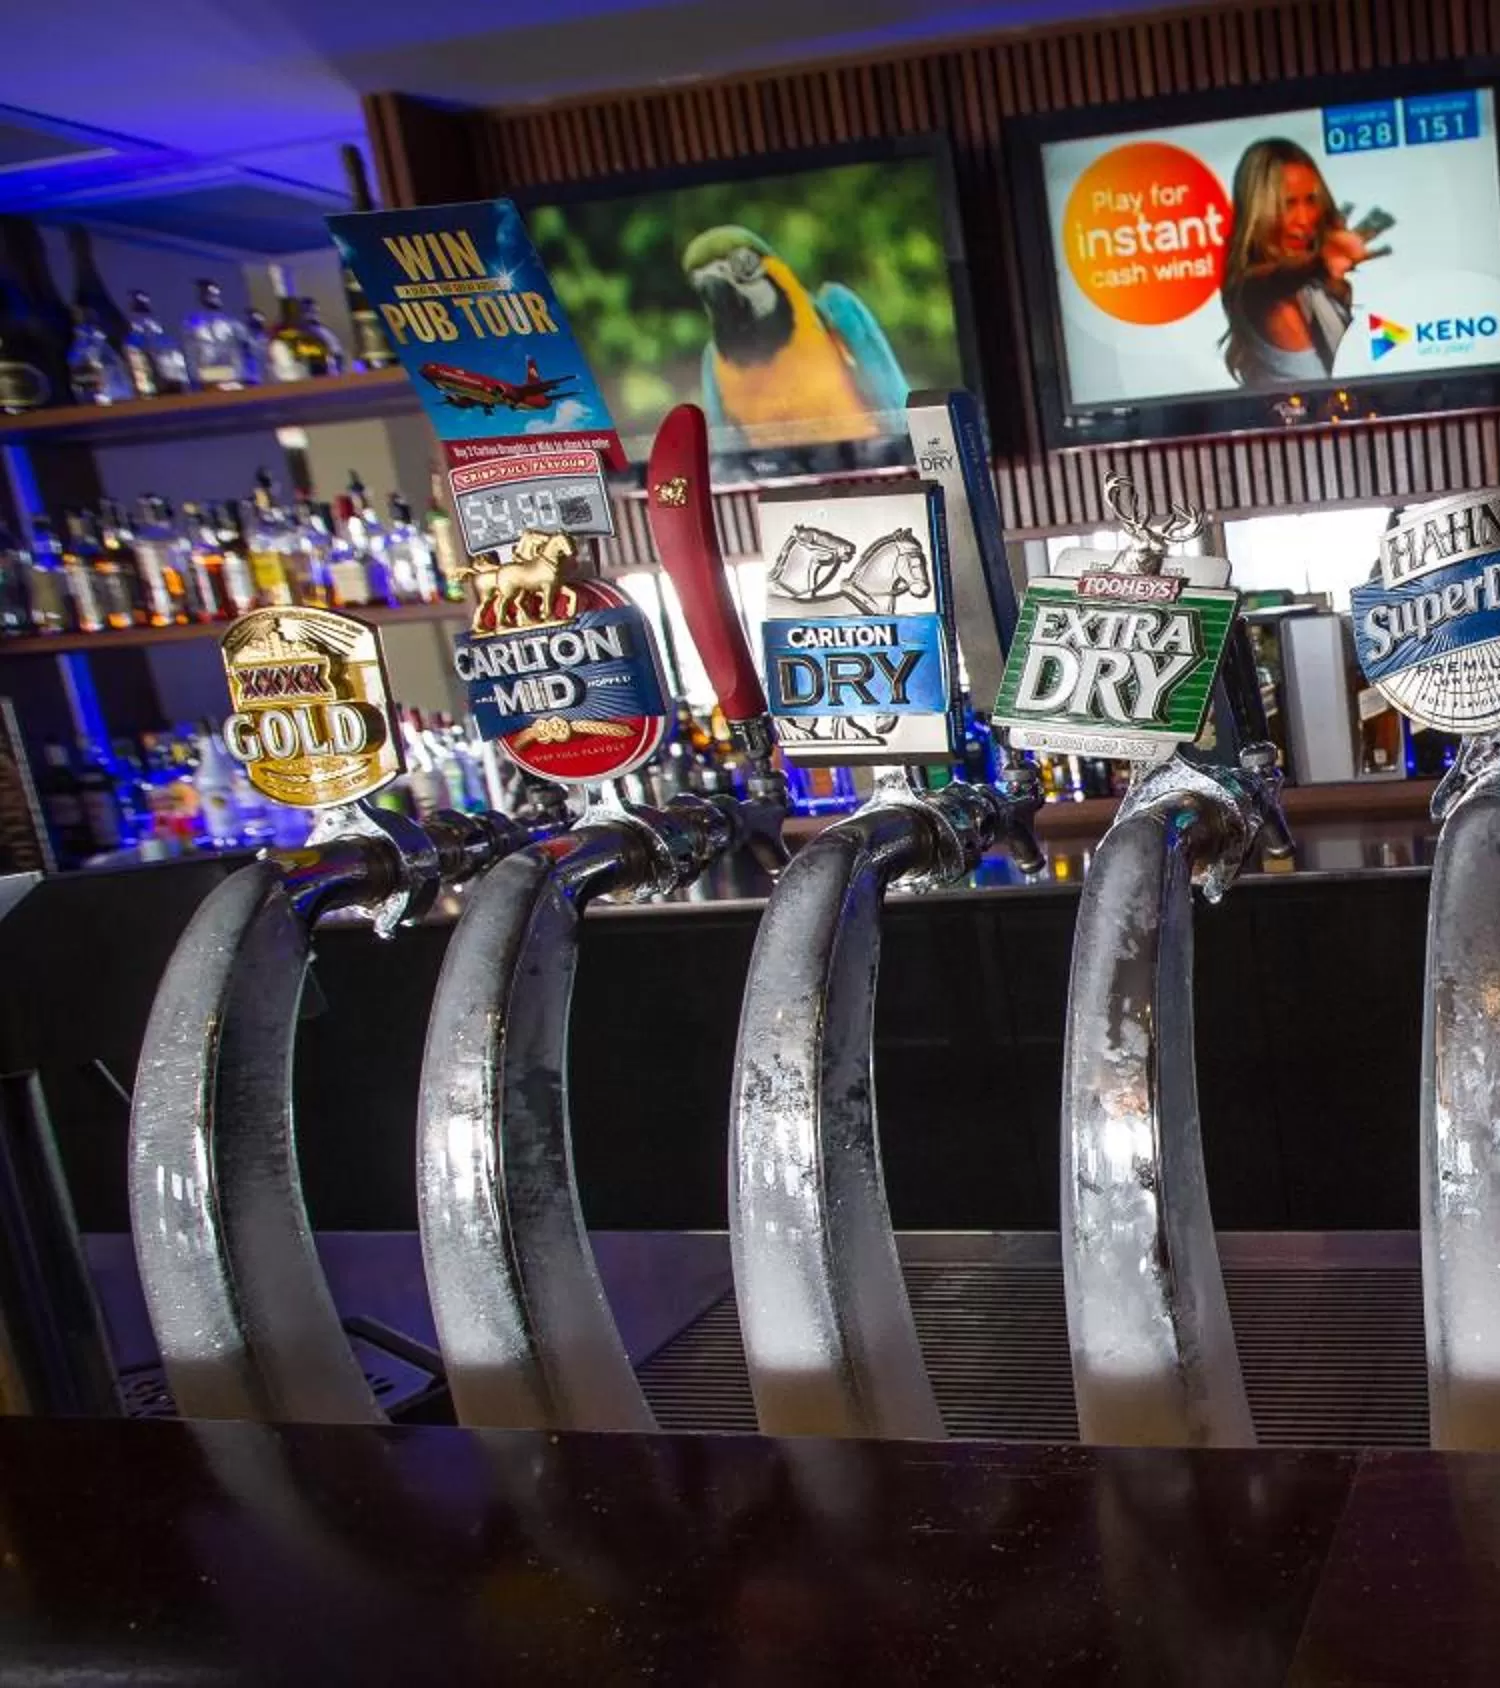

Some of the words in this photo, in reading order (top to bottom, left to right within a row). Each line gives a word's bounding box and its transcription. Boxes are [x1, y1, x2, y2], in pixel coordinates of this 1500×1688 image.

[1417, 115, 1466, 141] 151
[1092, 188, 1143, 214] Play
[1150, 183, 1189, 207] for
[1076, 203, 1225, 263] instant
[383, 230, 487, 281] WIN
[1091, 262, 1147, 290] cash
[1158, 255, 1215, 282] wins!
[379, 301, 459, 344] PUB
[452, 291, 560, 339] TOUR
[1416, 315, 1497, 344] KENO
[500, 464, 529, 476] FULL
[920, 456, 954, 471] DRY
[1083, 576, 1172, 599] TOOHEYS
[787, 624, 893, 649] CARLTON
[1030, 604, 1195, 654] EXTRA
[453, 623, 625, 681] CARLTON
[236, 663, 322, 699] XXXX
[493, 673, 577, 717] MID
[775, 650, 923, 707] DRY
[1014, 643, 1194, 723] DRY
[223, 705, 367, 763] GOLD
